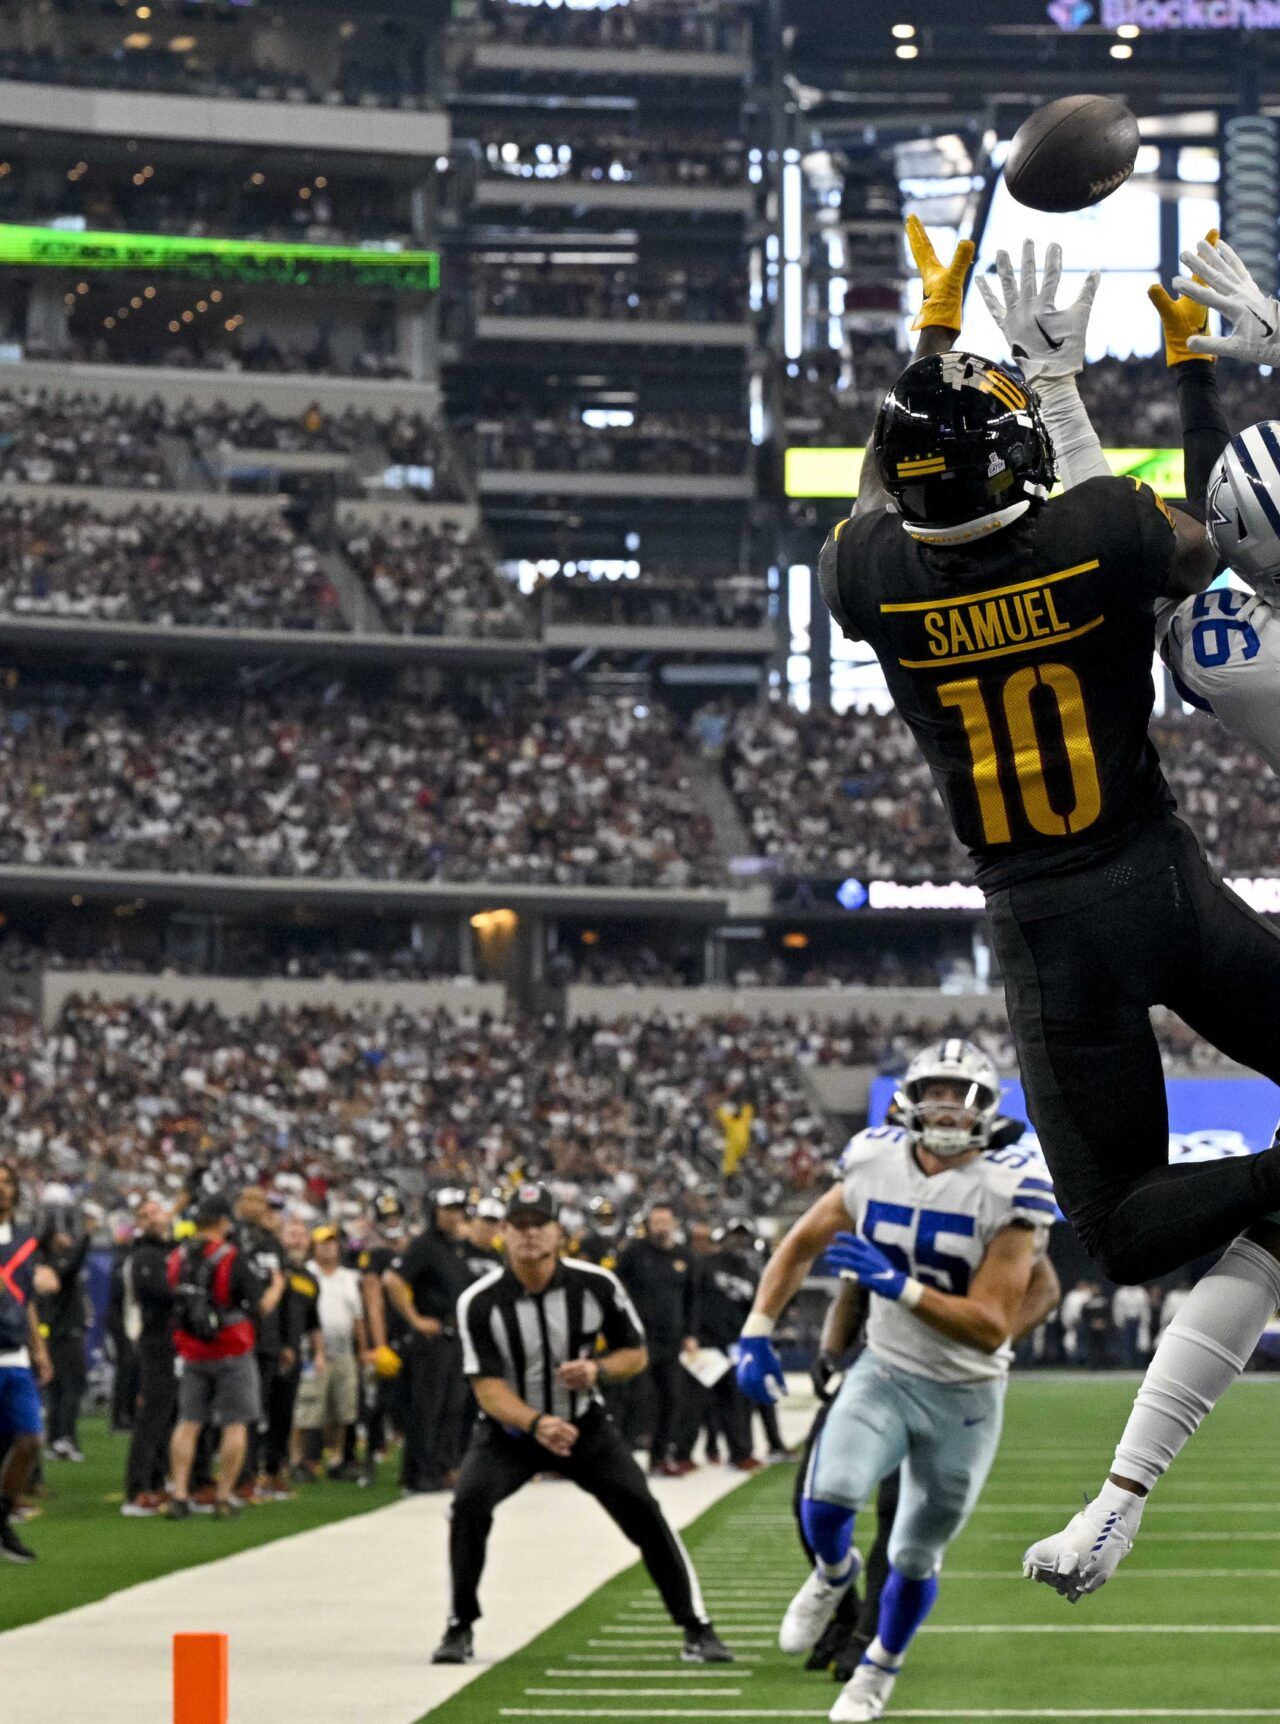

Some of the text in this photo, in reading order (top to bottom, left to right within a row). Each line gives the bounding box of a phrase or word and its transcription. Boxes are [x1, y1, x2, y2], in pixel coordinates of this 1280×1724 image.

[924, 588, 1070, 657] SAMUEL
[936, 663, 1102, 844] 10
[863, 1200, 975, 1296] 55
